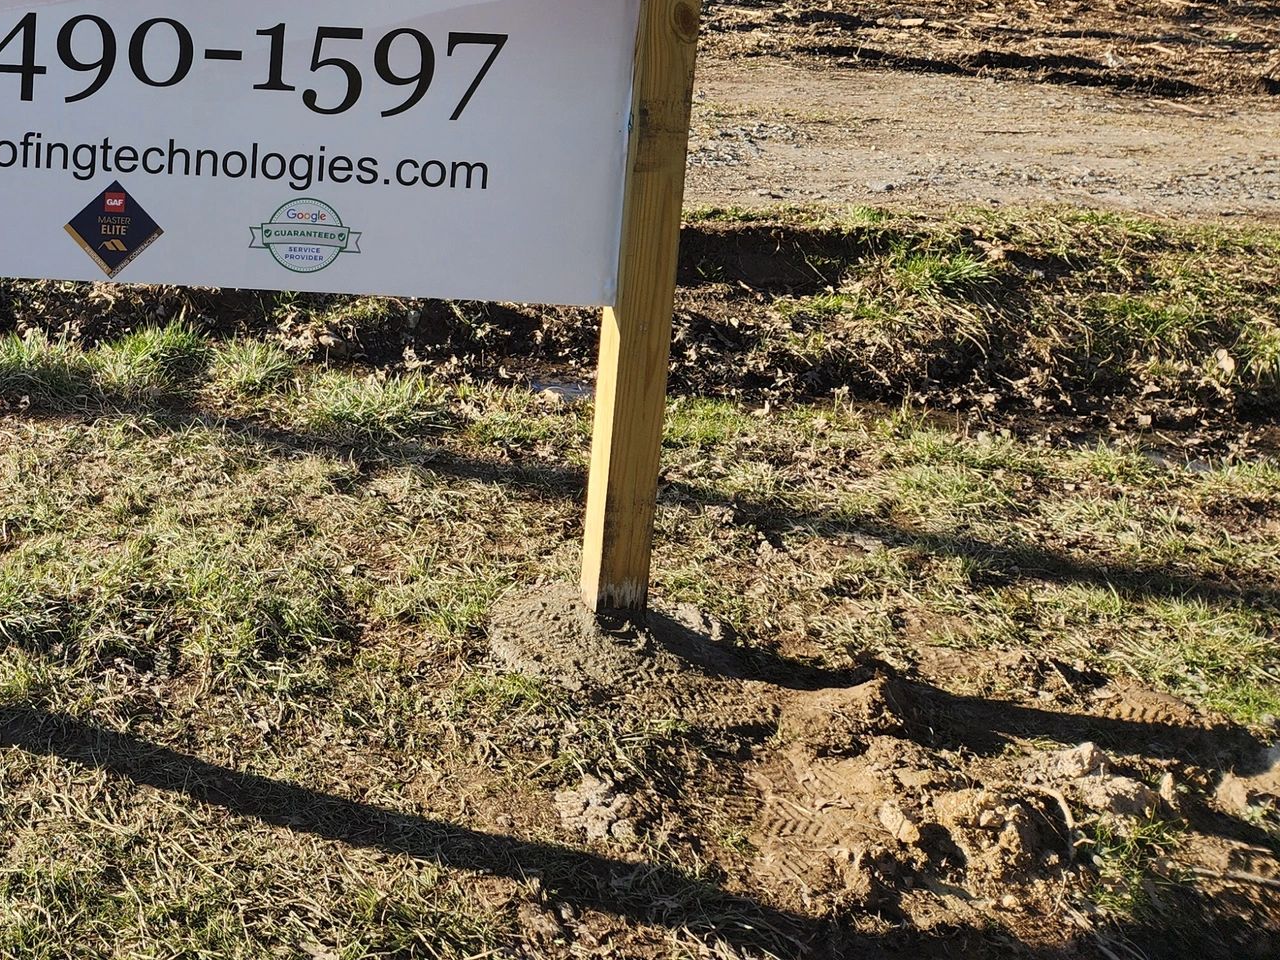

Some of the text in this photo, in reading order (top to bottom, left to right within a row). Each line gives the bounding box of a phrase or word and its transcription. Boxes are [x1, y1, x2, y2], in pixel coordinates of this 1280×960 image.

[97, 216, 131, 224] MASTER
[286, 208, 327, 223] Google
[101, 225, 127, 235] ELITE
[274, 229, 336, 240] GUARANTEED
[288, 246, 321, 254] SERVICE
[284, 253, 324, 261] PROVIDER
